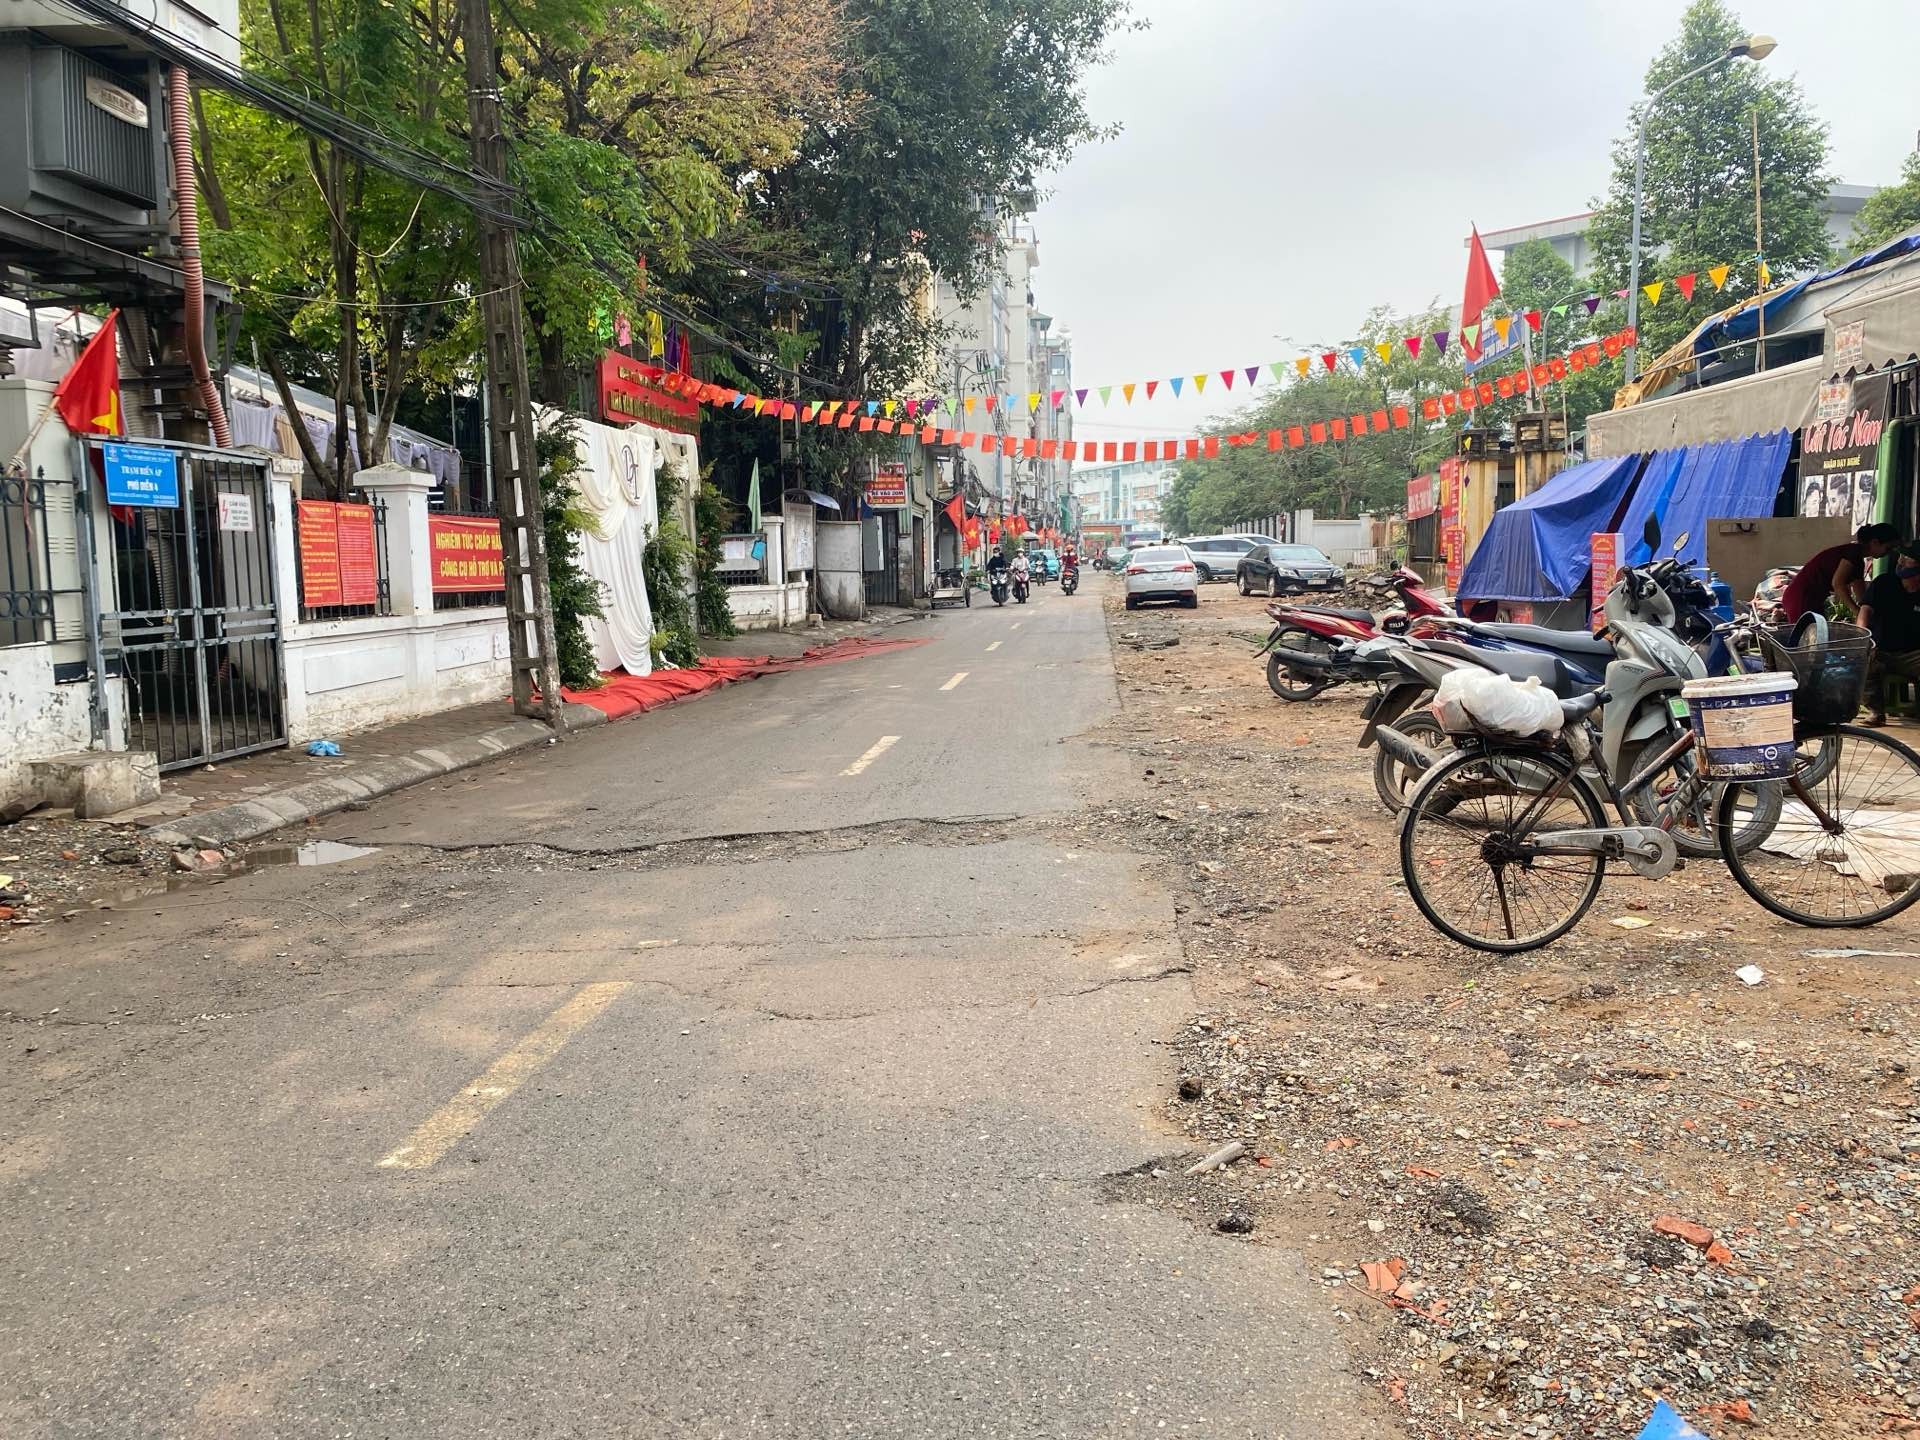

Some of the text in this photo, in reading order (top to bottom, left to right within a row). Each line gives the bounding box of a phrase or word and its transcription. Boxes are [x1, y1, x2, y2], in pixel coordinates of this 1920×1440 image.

[435, 529, 461, 550] NGHIÊM
[461, 530, 474, 550] TÚC
[474, 528, 490, 550] CHẤP
[440, 557, 458, 577] CÔNG
